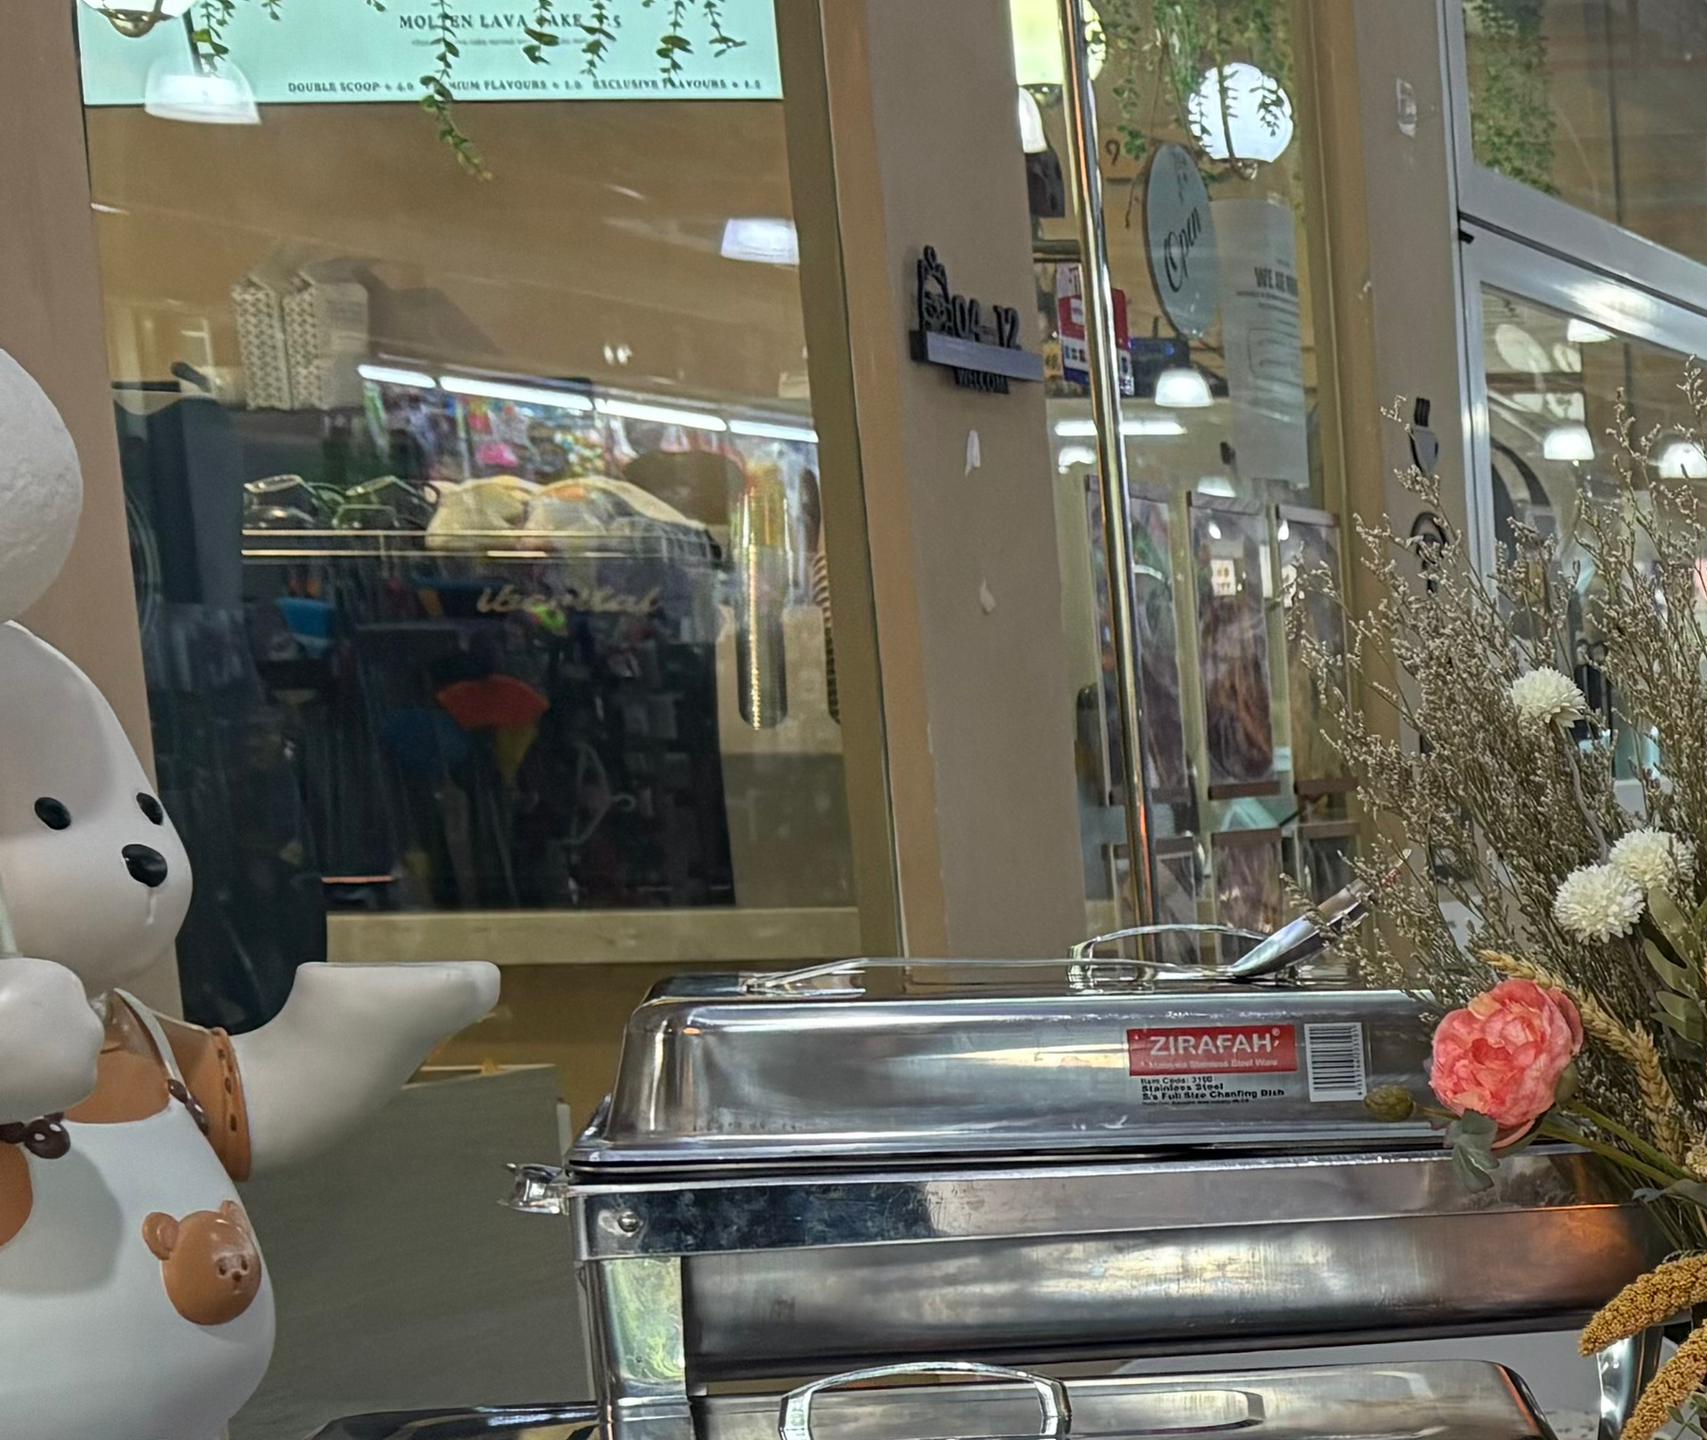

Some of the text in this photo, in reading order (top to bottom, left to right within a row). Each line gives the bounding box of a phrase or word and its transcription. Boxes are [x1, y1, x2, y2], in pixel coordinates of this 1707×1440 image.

[480, 14, 529, 28] LAVA
[288, 82, 337, 92] DOUBLE
[341, 82, 380, 92] SCOOP
[485, 80, 547, 90] FLAVOURS
[594, 79, 658, 90] EXCLUSIVE
[663, 78, 728, 89] FLAVOURS
[1163, 207, 1202, 293] Open
[1150, 1032, 1272, 1056] ZIRAFAH
[1142, 1082, 1224, 1093] Stainless Steel
[1162, 1092, 1182, 1100] Full
[1184, 1091, 1207, 1099] Size
[1261, 1088, 1285, 1097] Dish
